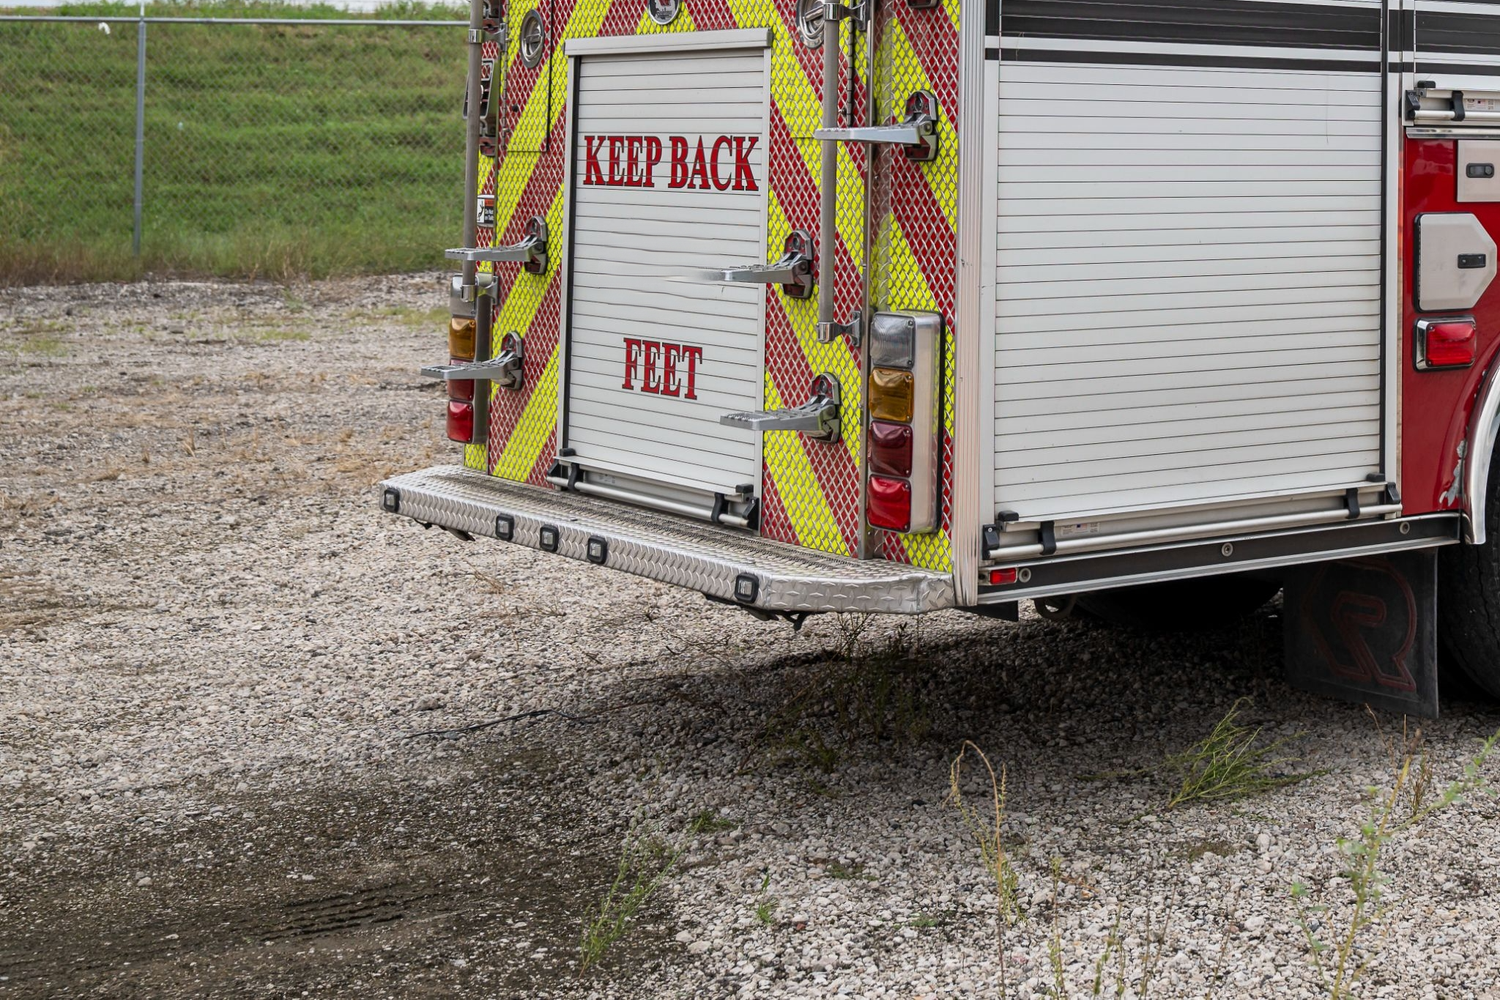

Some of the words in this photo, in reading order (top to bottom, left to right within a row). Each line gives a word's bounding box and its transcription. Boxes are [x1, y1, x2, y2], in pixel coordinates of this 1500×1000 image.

[583, 135, 663, 188] KEEP
[667, 135, 759, 191] BACK
[622, 337, 703, 400] FEET
